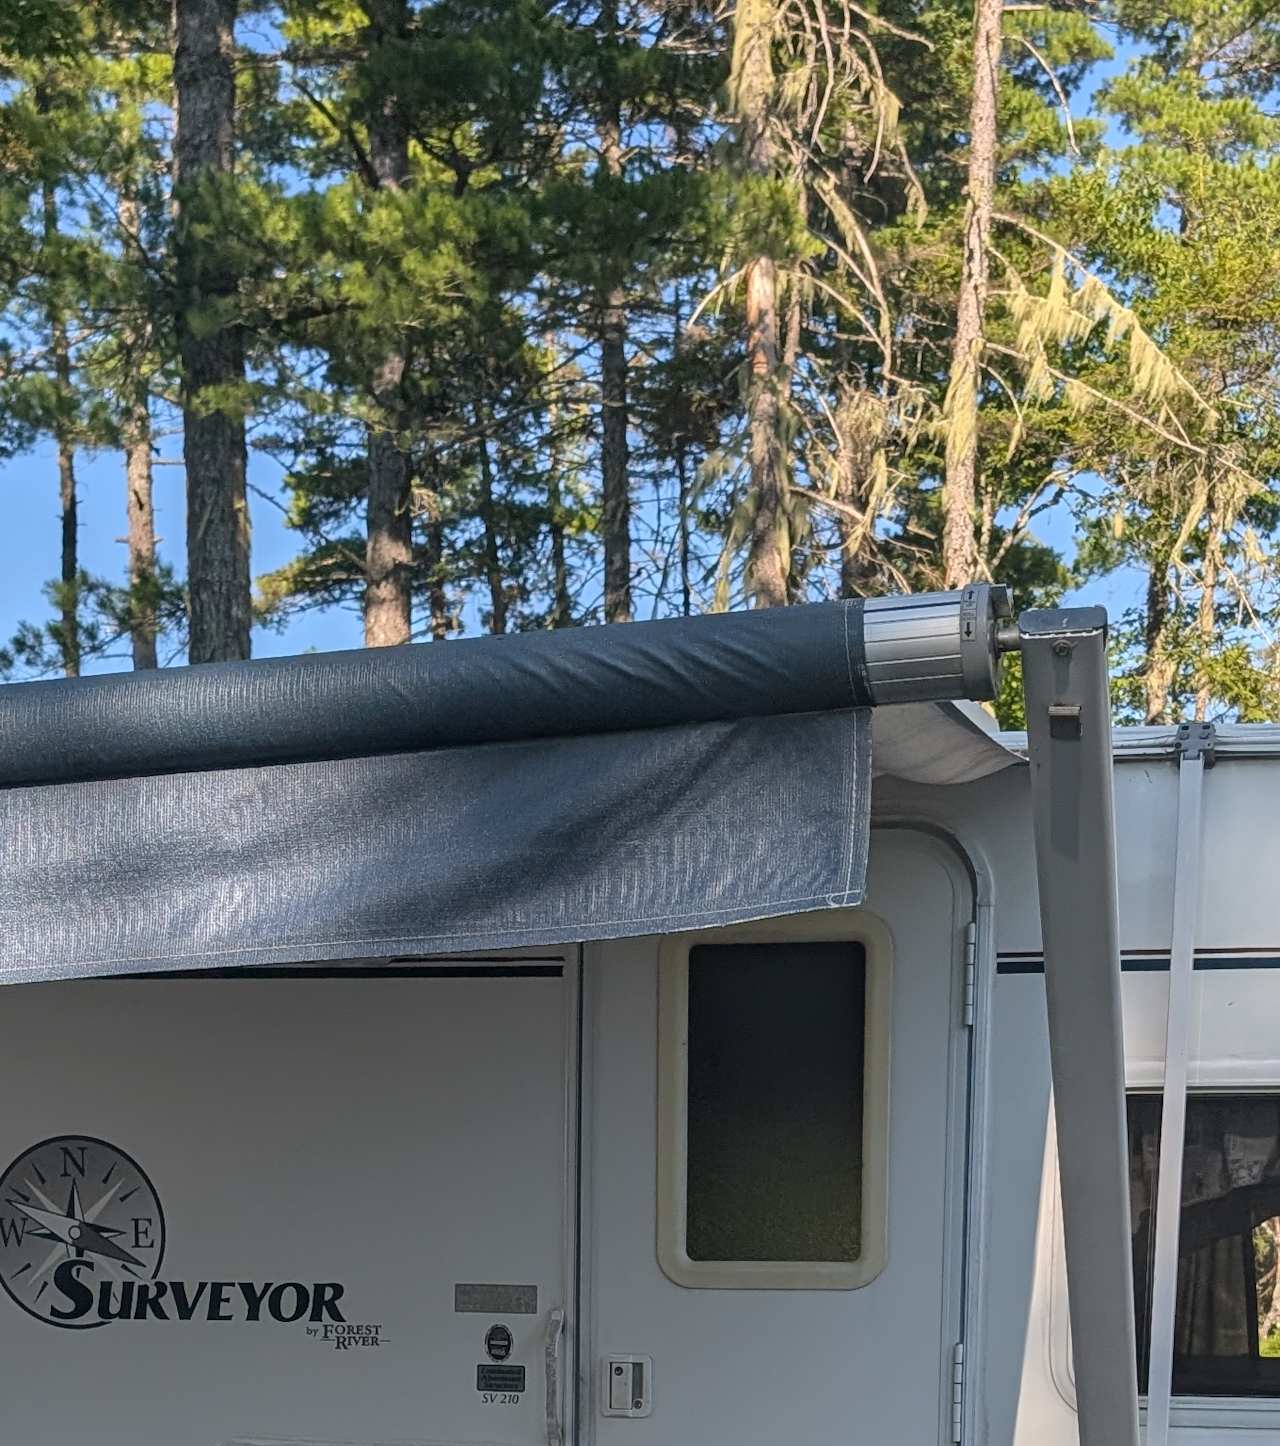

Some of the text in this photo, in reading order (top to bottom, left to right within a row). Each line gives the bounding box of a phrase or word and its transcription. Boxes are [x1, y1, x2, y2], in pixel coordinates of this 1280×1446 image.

[60, 1147, 87, 1177] N
[131, 1217, 155, 1249] E
[50, 1260, 346, 1321] SURVEYOR
[305, 1324, 382, 1339] by FOREST
[335, 1336, 380, 1350] RIVER
[482, 1393, 520, 1405] SV 210
